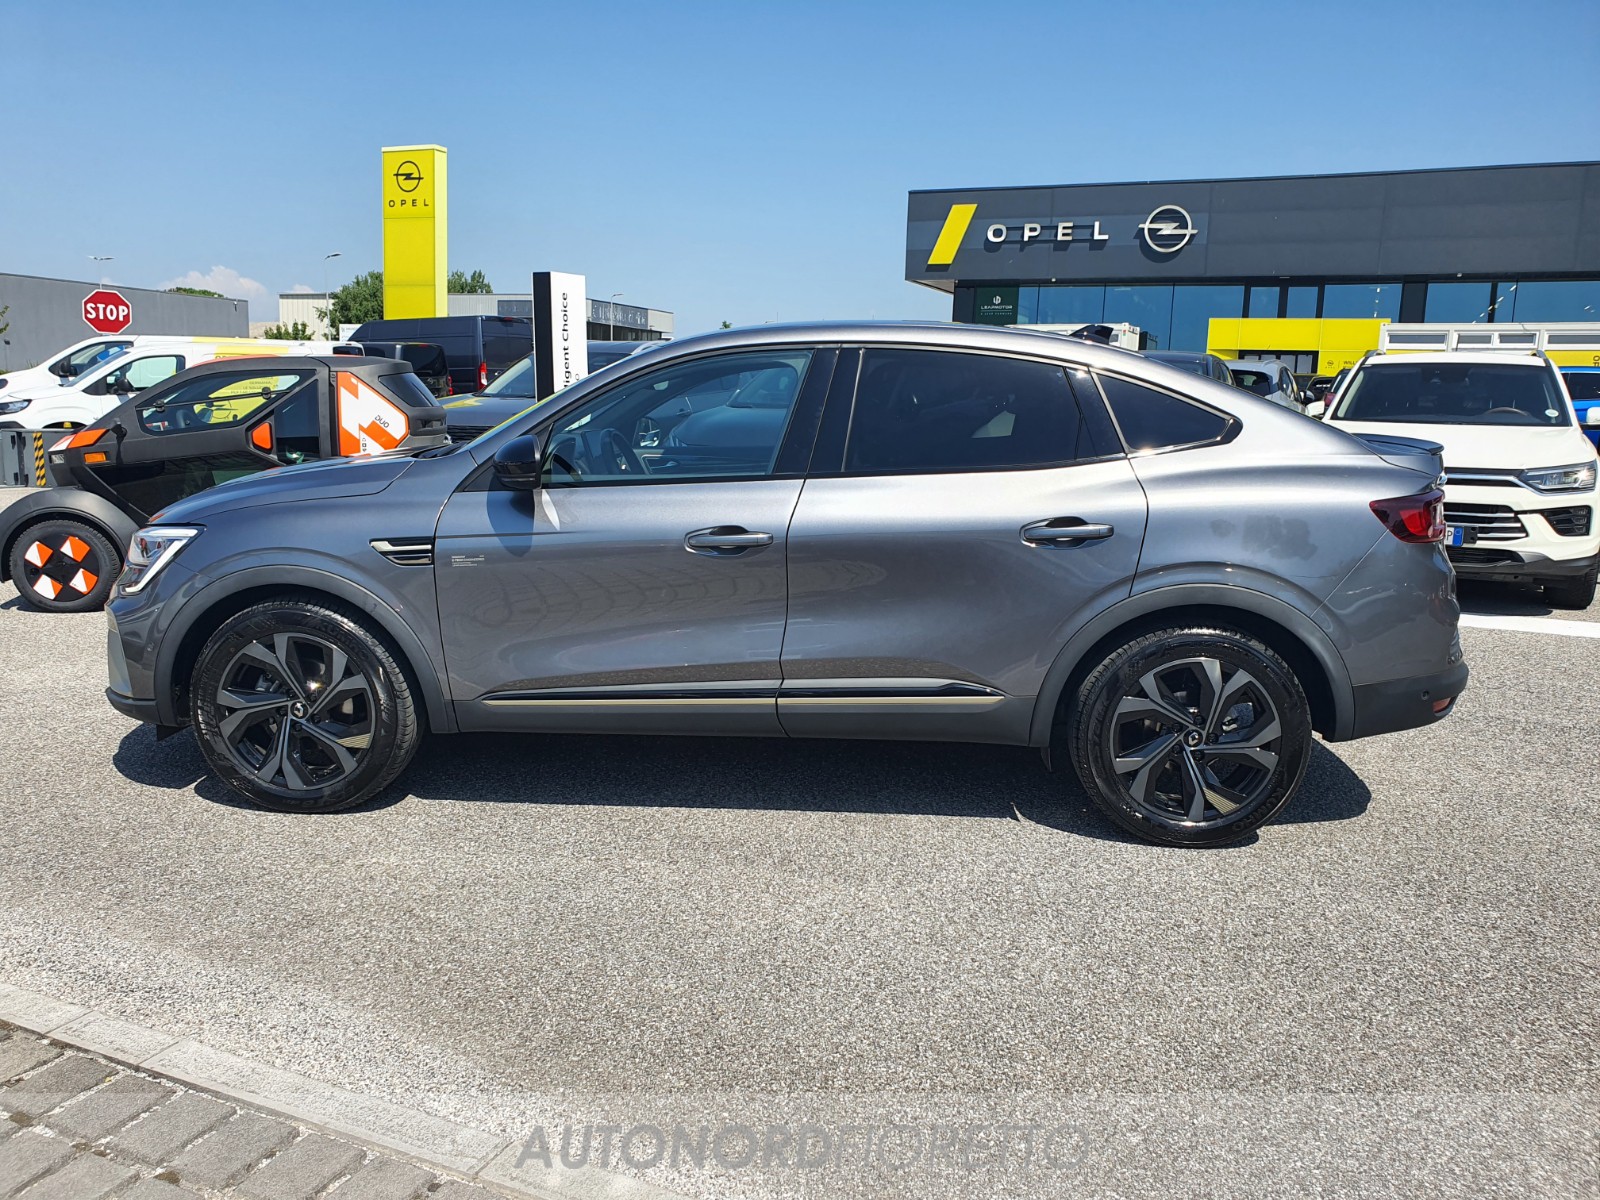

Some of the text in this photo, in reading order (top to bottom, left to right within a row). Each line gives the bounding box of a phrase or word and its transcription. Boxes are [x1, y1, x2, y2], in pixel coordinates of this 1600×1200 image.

[388, 198, 429, 208] OPEL
[986, 220, 1109, 243] OPEL
[86, 302, 129, 322] STOP
[561, 292, 572, 389] ligent Choice
[374, 414, 390, 429] DUO
